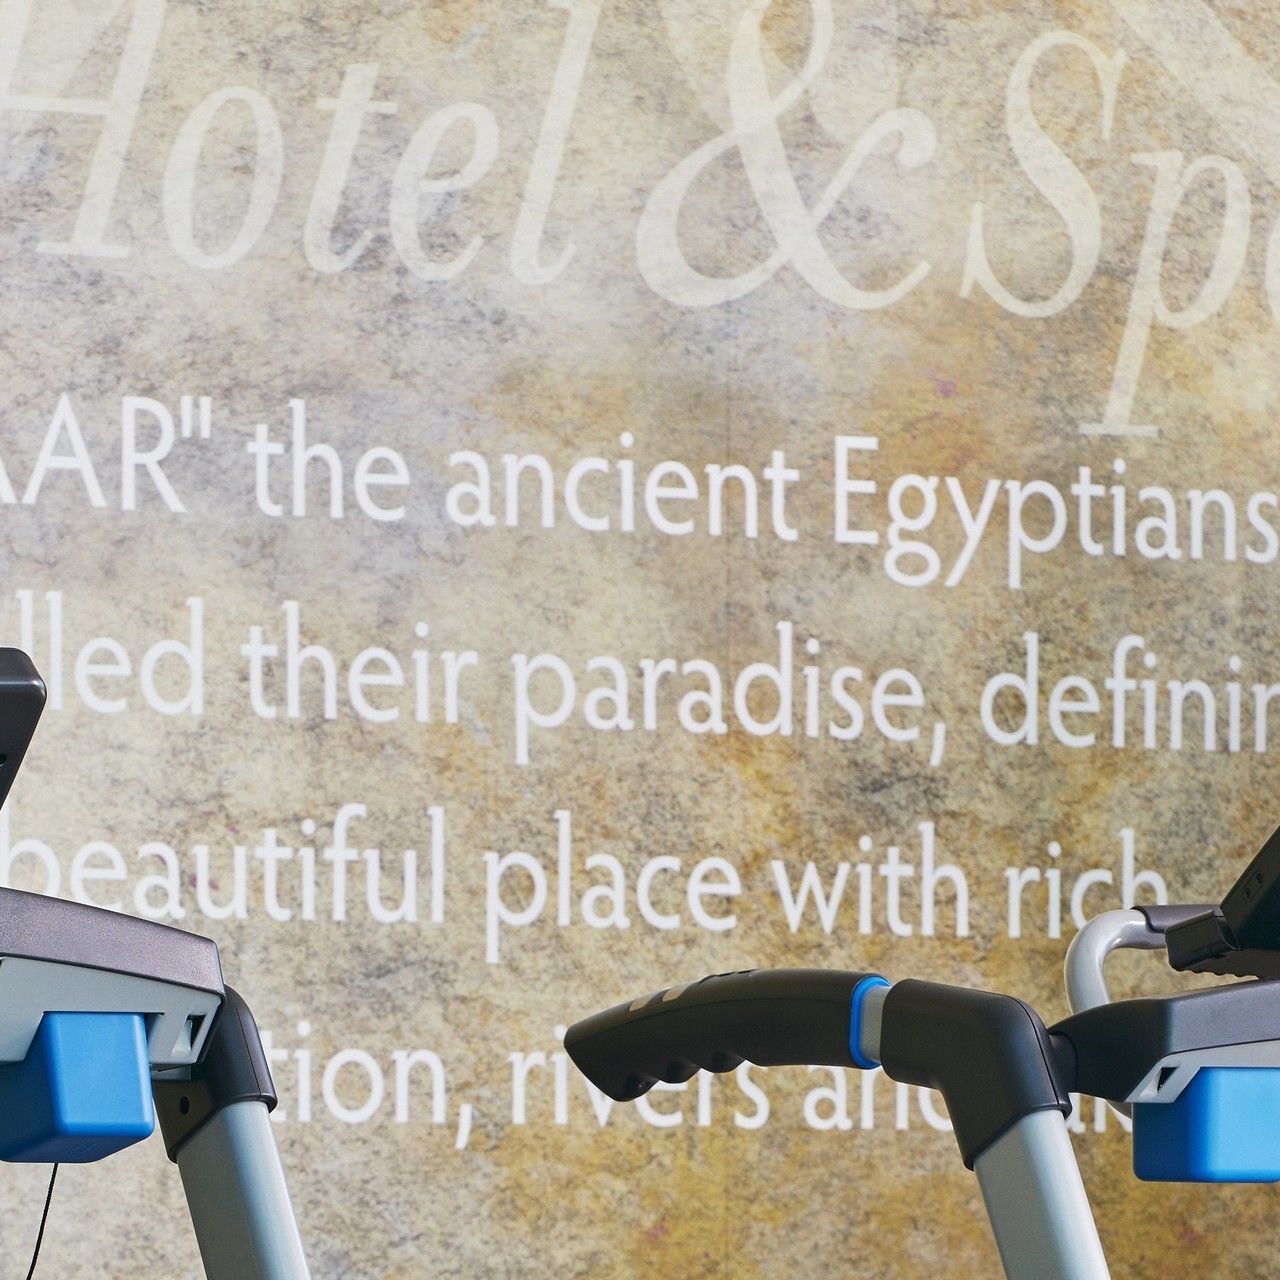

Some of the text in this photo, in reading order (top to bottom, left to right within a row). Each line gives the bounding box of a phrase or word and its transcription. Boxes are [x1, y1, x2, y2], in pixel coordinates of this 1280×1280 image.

[635, 0, 937, 311] &
[247, 399, 410, 522] the
[444, 432, 801, 541] ancient
[834, 436, 1280, 590] Egyptians
[241, 599, 478, 725] their
[512, 620, 948, 766] paradise,
[482, 808, 742, 964] place
[770, 821, 970, 938] with
[1004, 827, 1169, 940] rich
